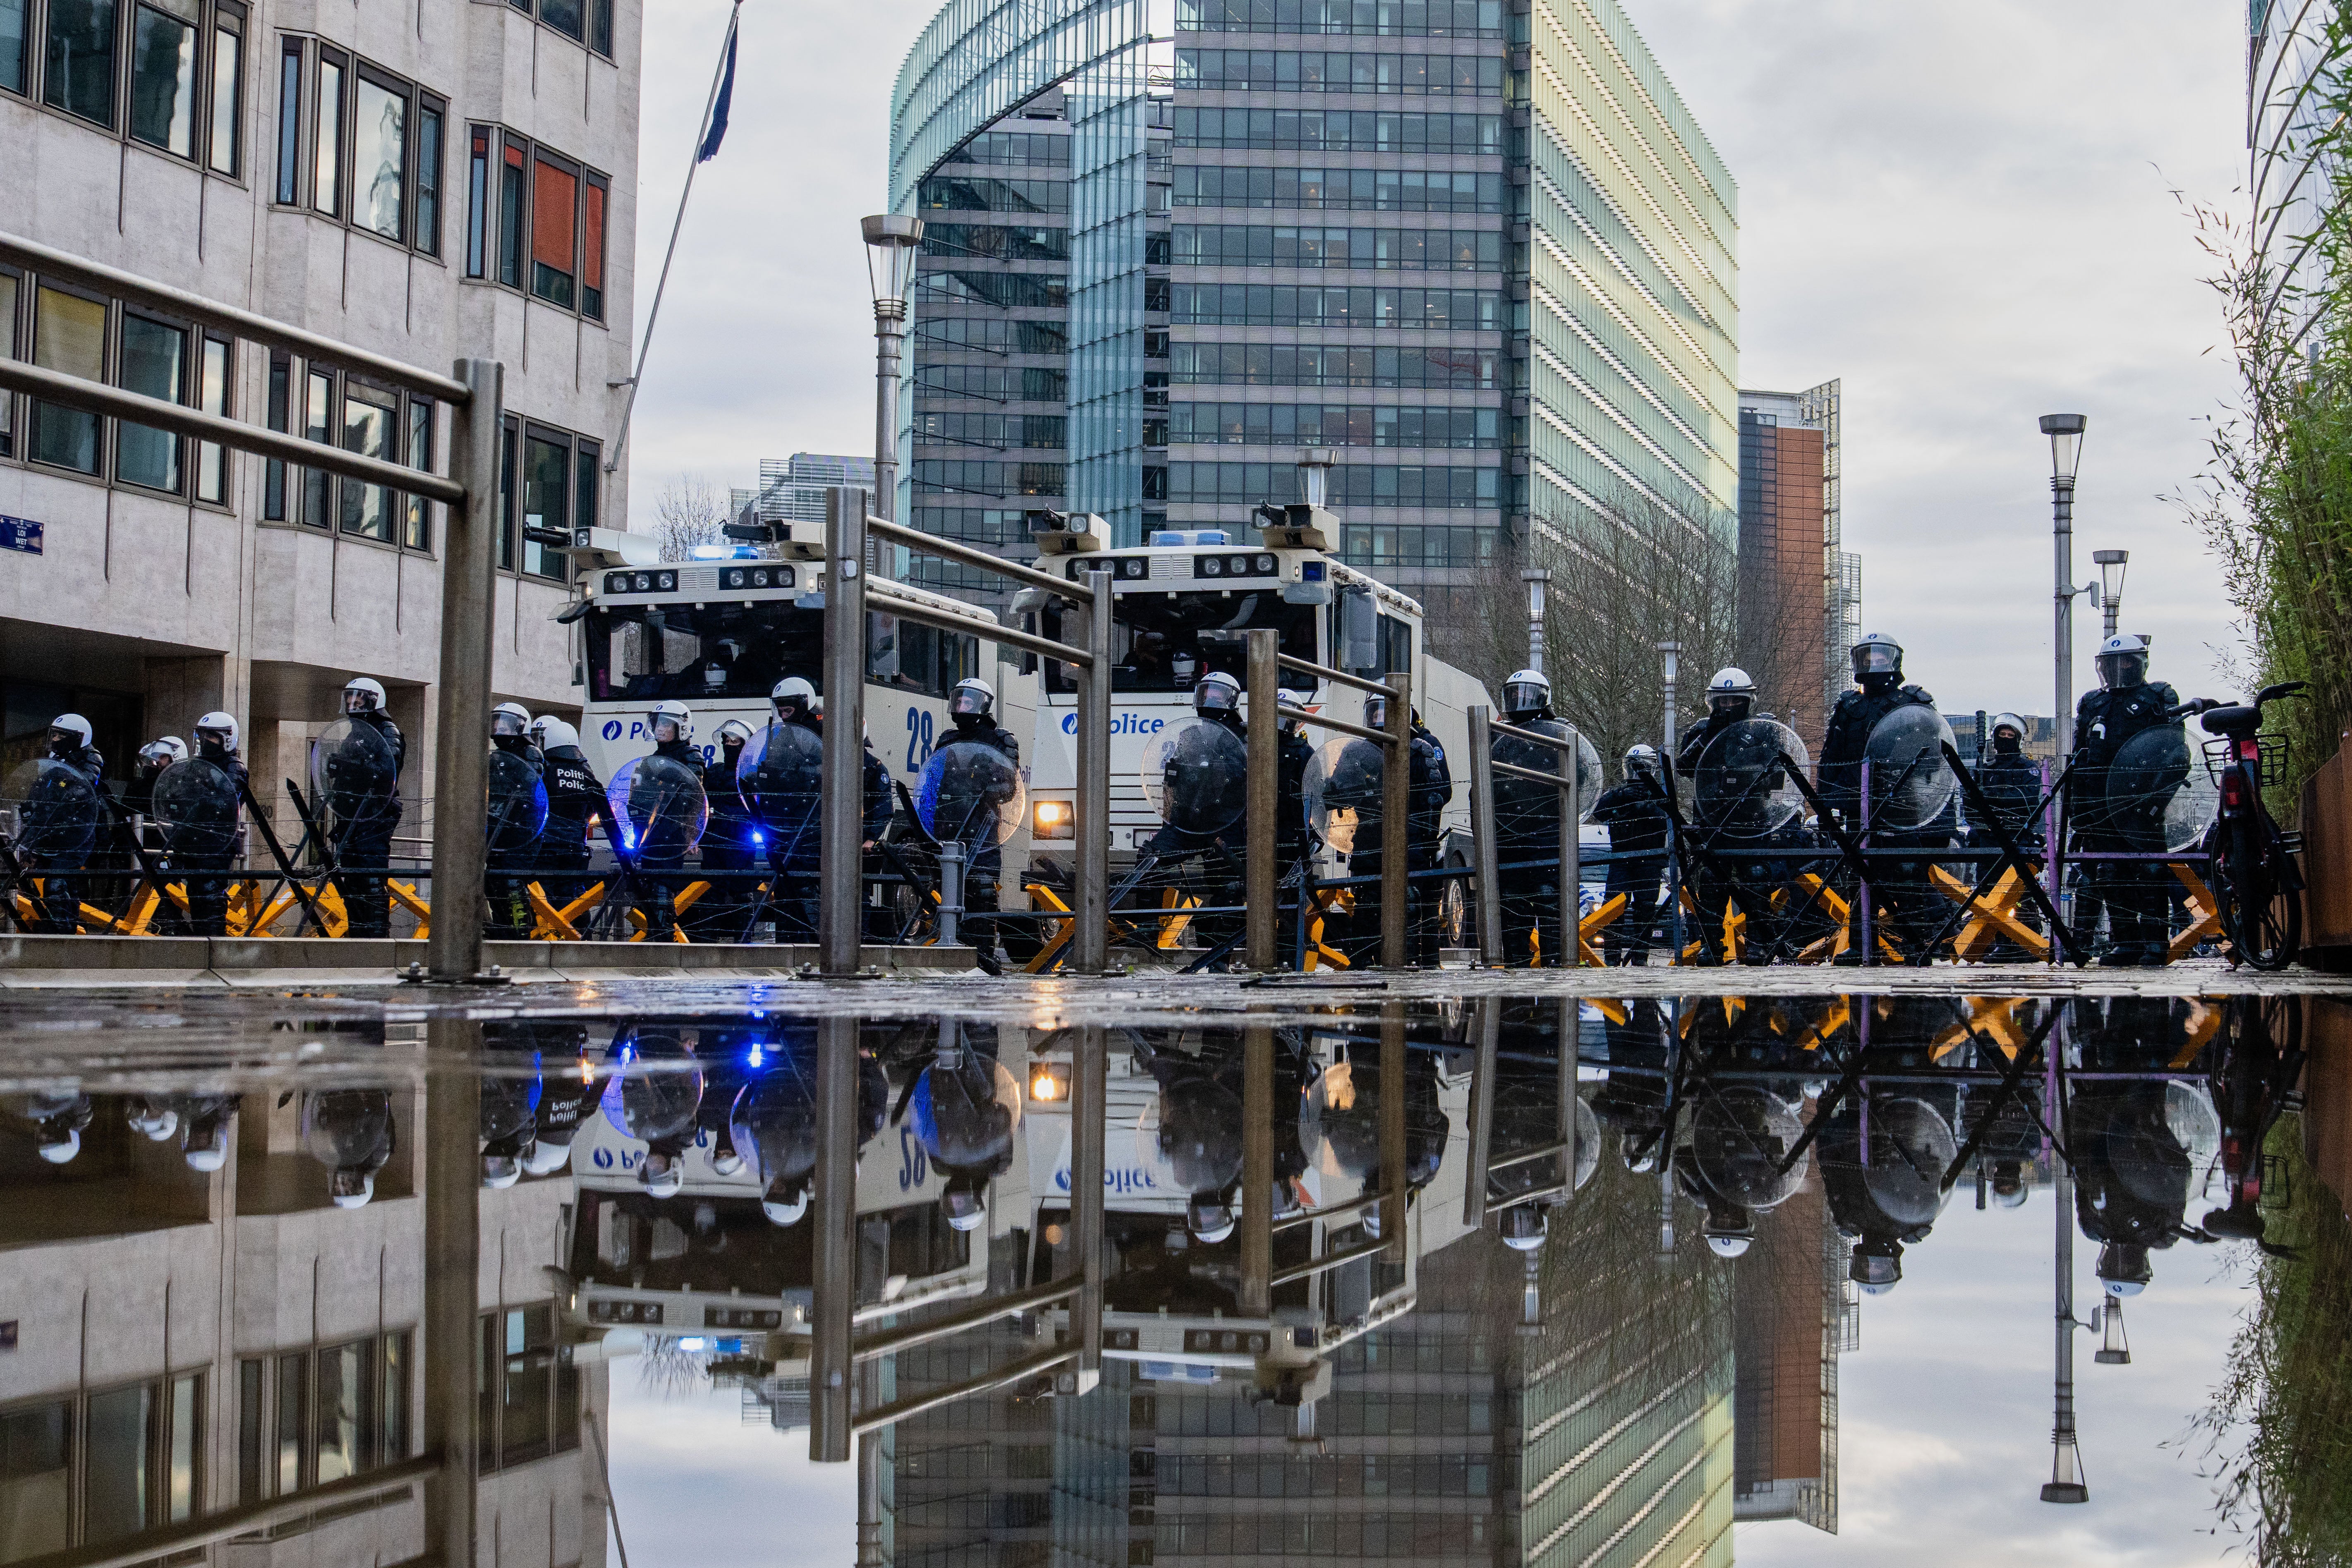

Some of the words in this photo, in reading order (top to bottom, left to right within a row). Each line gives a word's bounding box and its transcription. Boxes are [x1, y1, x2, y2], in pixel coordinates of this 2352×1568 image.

[1110, 713, 1164, 734] olice
[907, 707, 933, 773] 28
[691, 745, 716, 769] 8
[1159, 741, 1176, 770] 2
[557, 768, 584, 780] Politi
[1018, 765, 1031, 784] oli
[559, 779, 586, 790] Polic
[259, 805, 273, 819] 30
